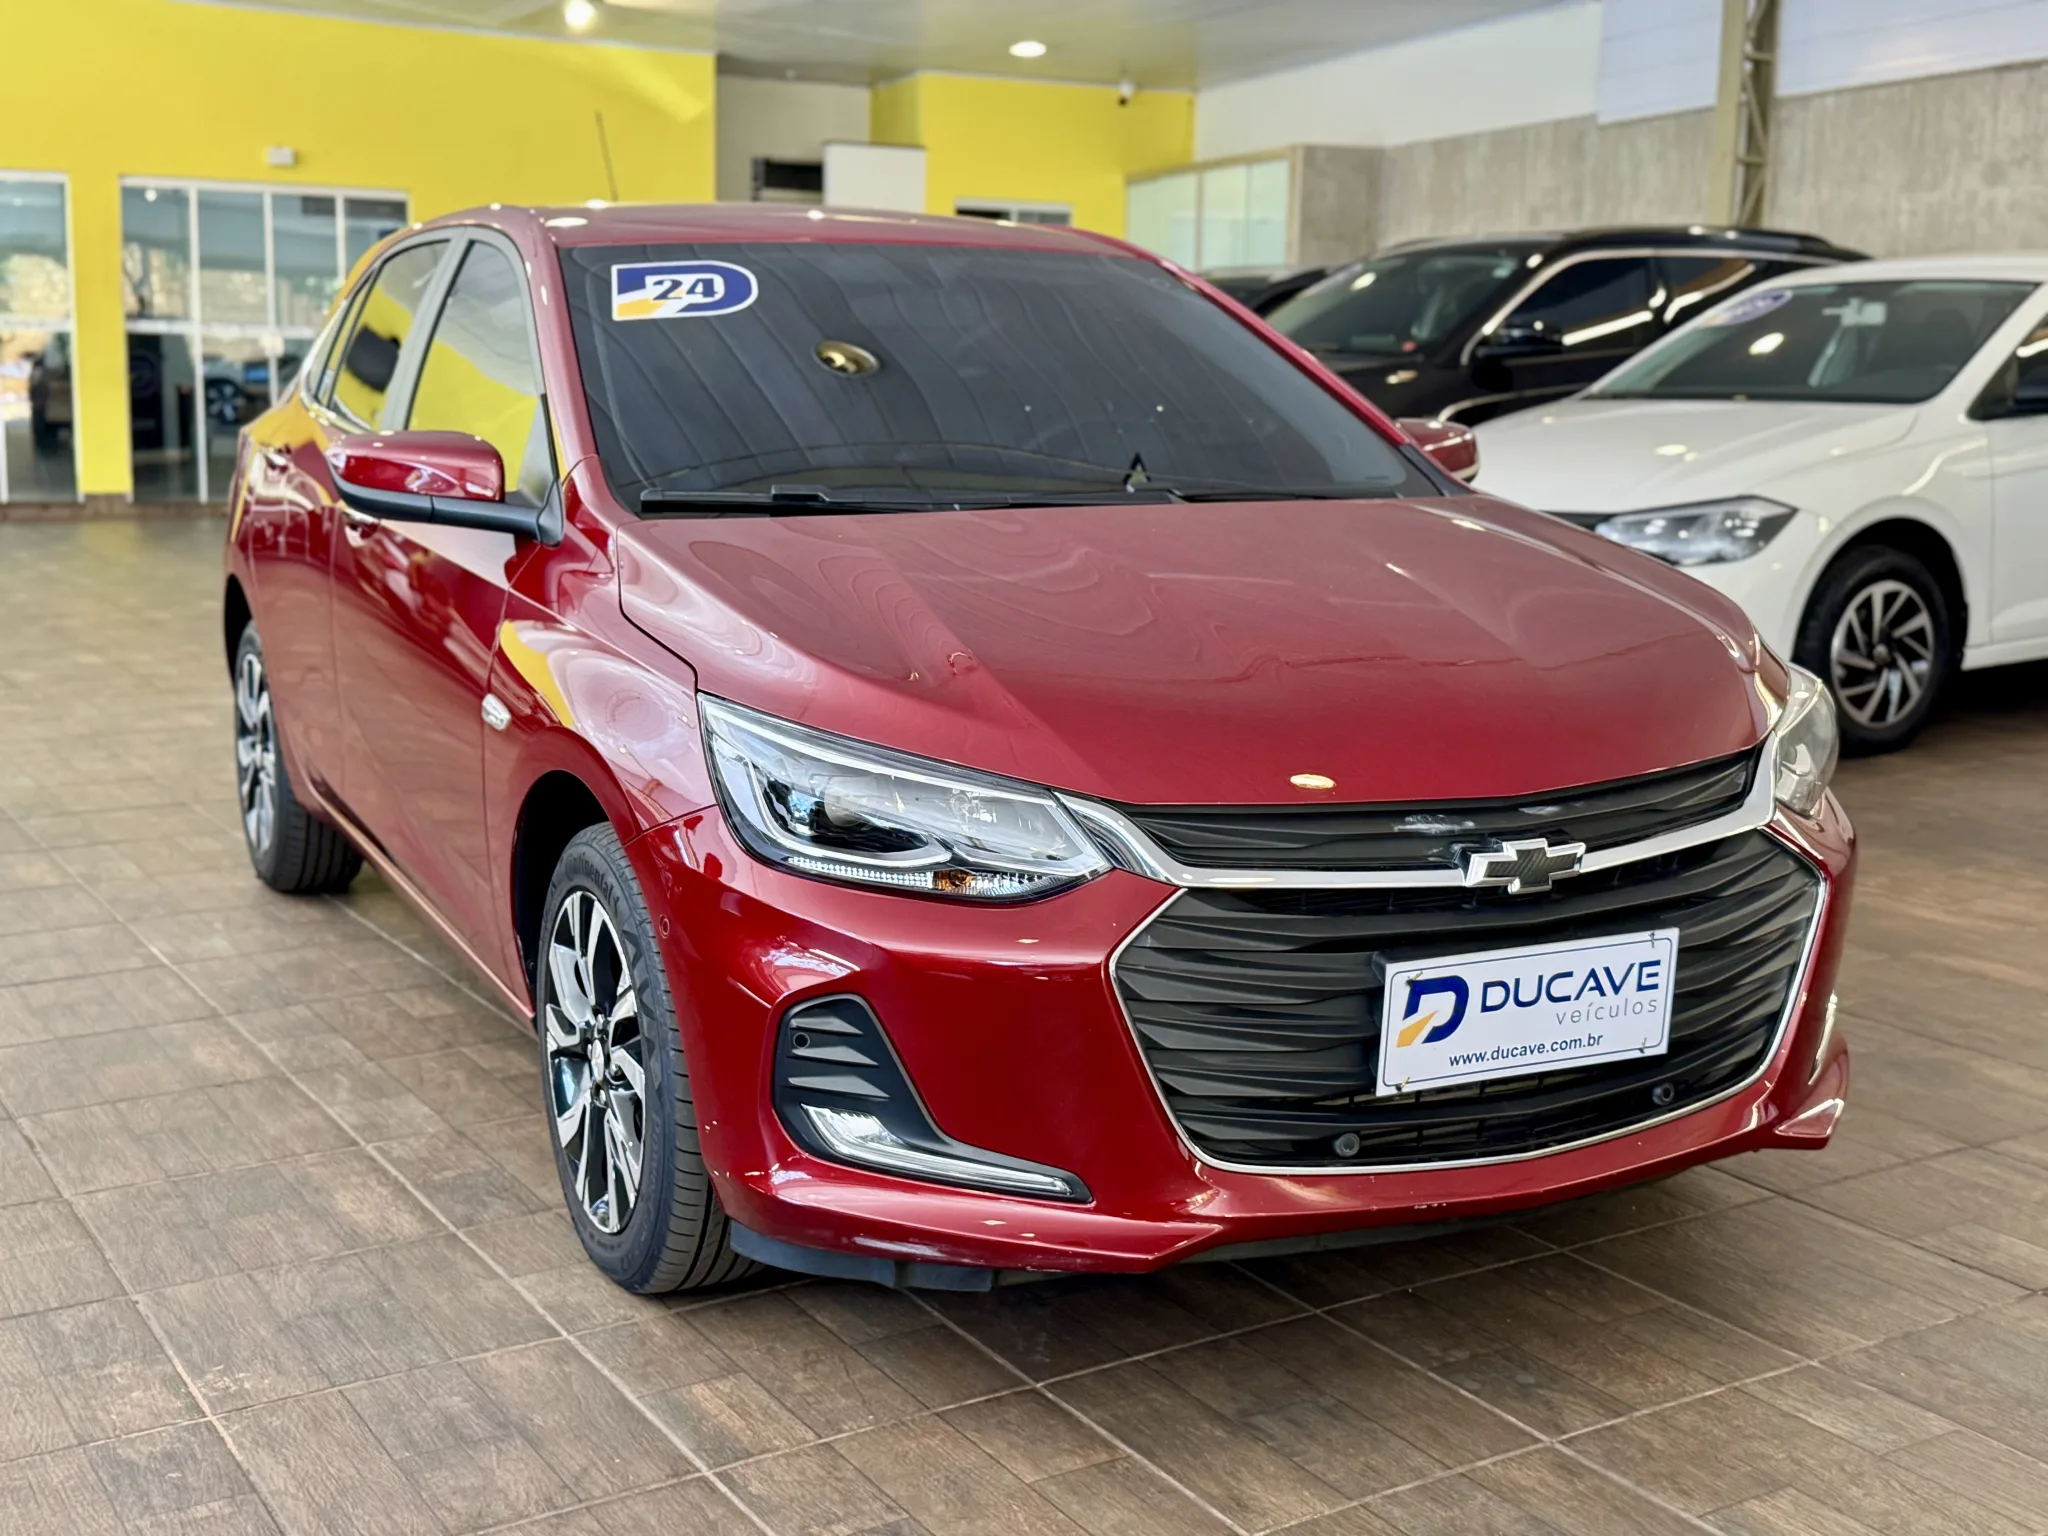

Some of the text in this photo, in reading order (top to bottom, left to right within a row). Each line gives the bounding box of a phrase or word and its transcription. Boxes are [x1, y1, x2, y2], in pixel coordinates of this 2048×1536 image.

[652, 278, 719, 301] 24
[1480, 959, 1661, 1014] DUCAVE
[1556, 998, 1658, 1025] veículos
[1449, 1033, 1604, 1067] www.ducave.com.br
